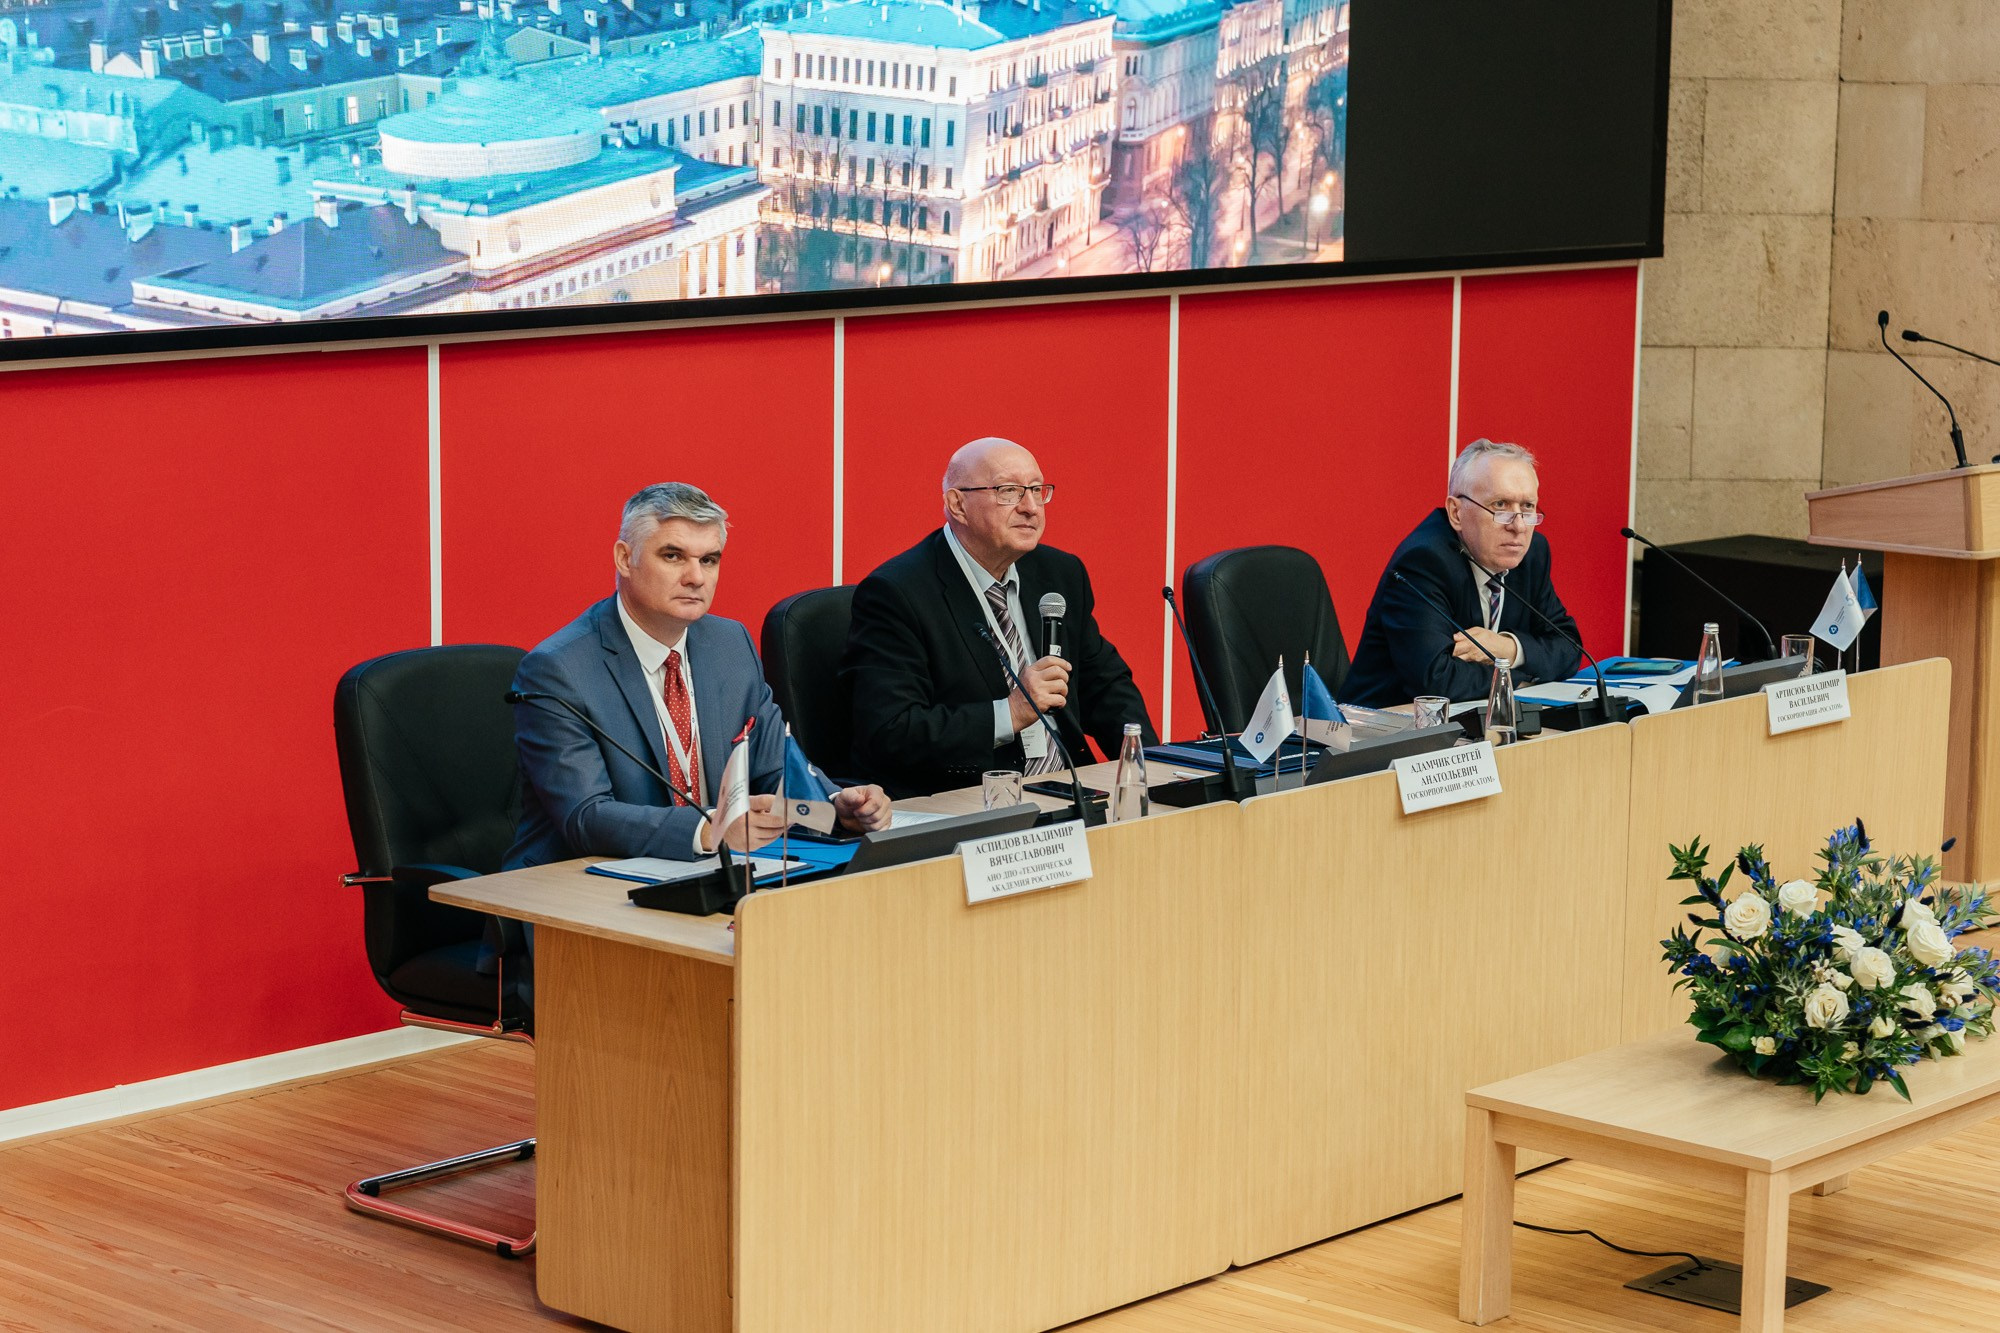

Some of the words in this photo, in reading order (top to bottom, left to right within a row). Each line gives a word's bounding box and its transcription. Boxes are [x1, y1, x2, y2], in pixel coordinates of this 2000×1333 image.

[1775, 686, 1807, 699] АРТИСЮК
[1807, 678, 1840, 692] ВЛАДИМИР
[1789, 692, 1830, 708] ВАСИЛЬЕВИЧ
[1411, 756, 1450, 773] АДАМЧИК
[1451, 748, 1482, 765] СЕРГЕЙ
[1421, 765, 1478, 786] АНАТОЛЬЕВИЧ
[975, 837, 1021, 855] АСПИДОВ
[1022, 826, 1074, 845] ВЛАДИМИР
[989, 843, 1065, 867] ВЯЧЕСЛАВОВИЧ
[986, 873, 1002, 883] АНО
[1003, 869, 1018, 881] ДПО
[1019, 857, 1073, 876] «ТЕХНИЧЕСКАЯ
[991, 878, 1031, 894] АКАДЕМИЯ
[1032, 870, 1073, 886] РОСАТОМА»
